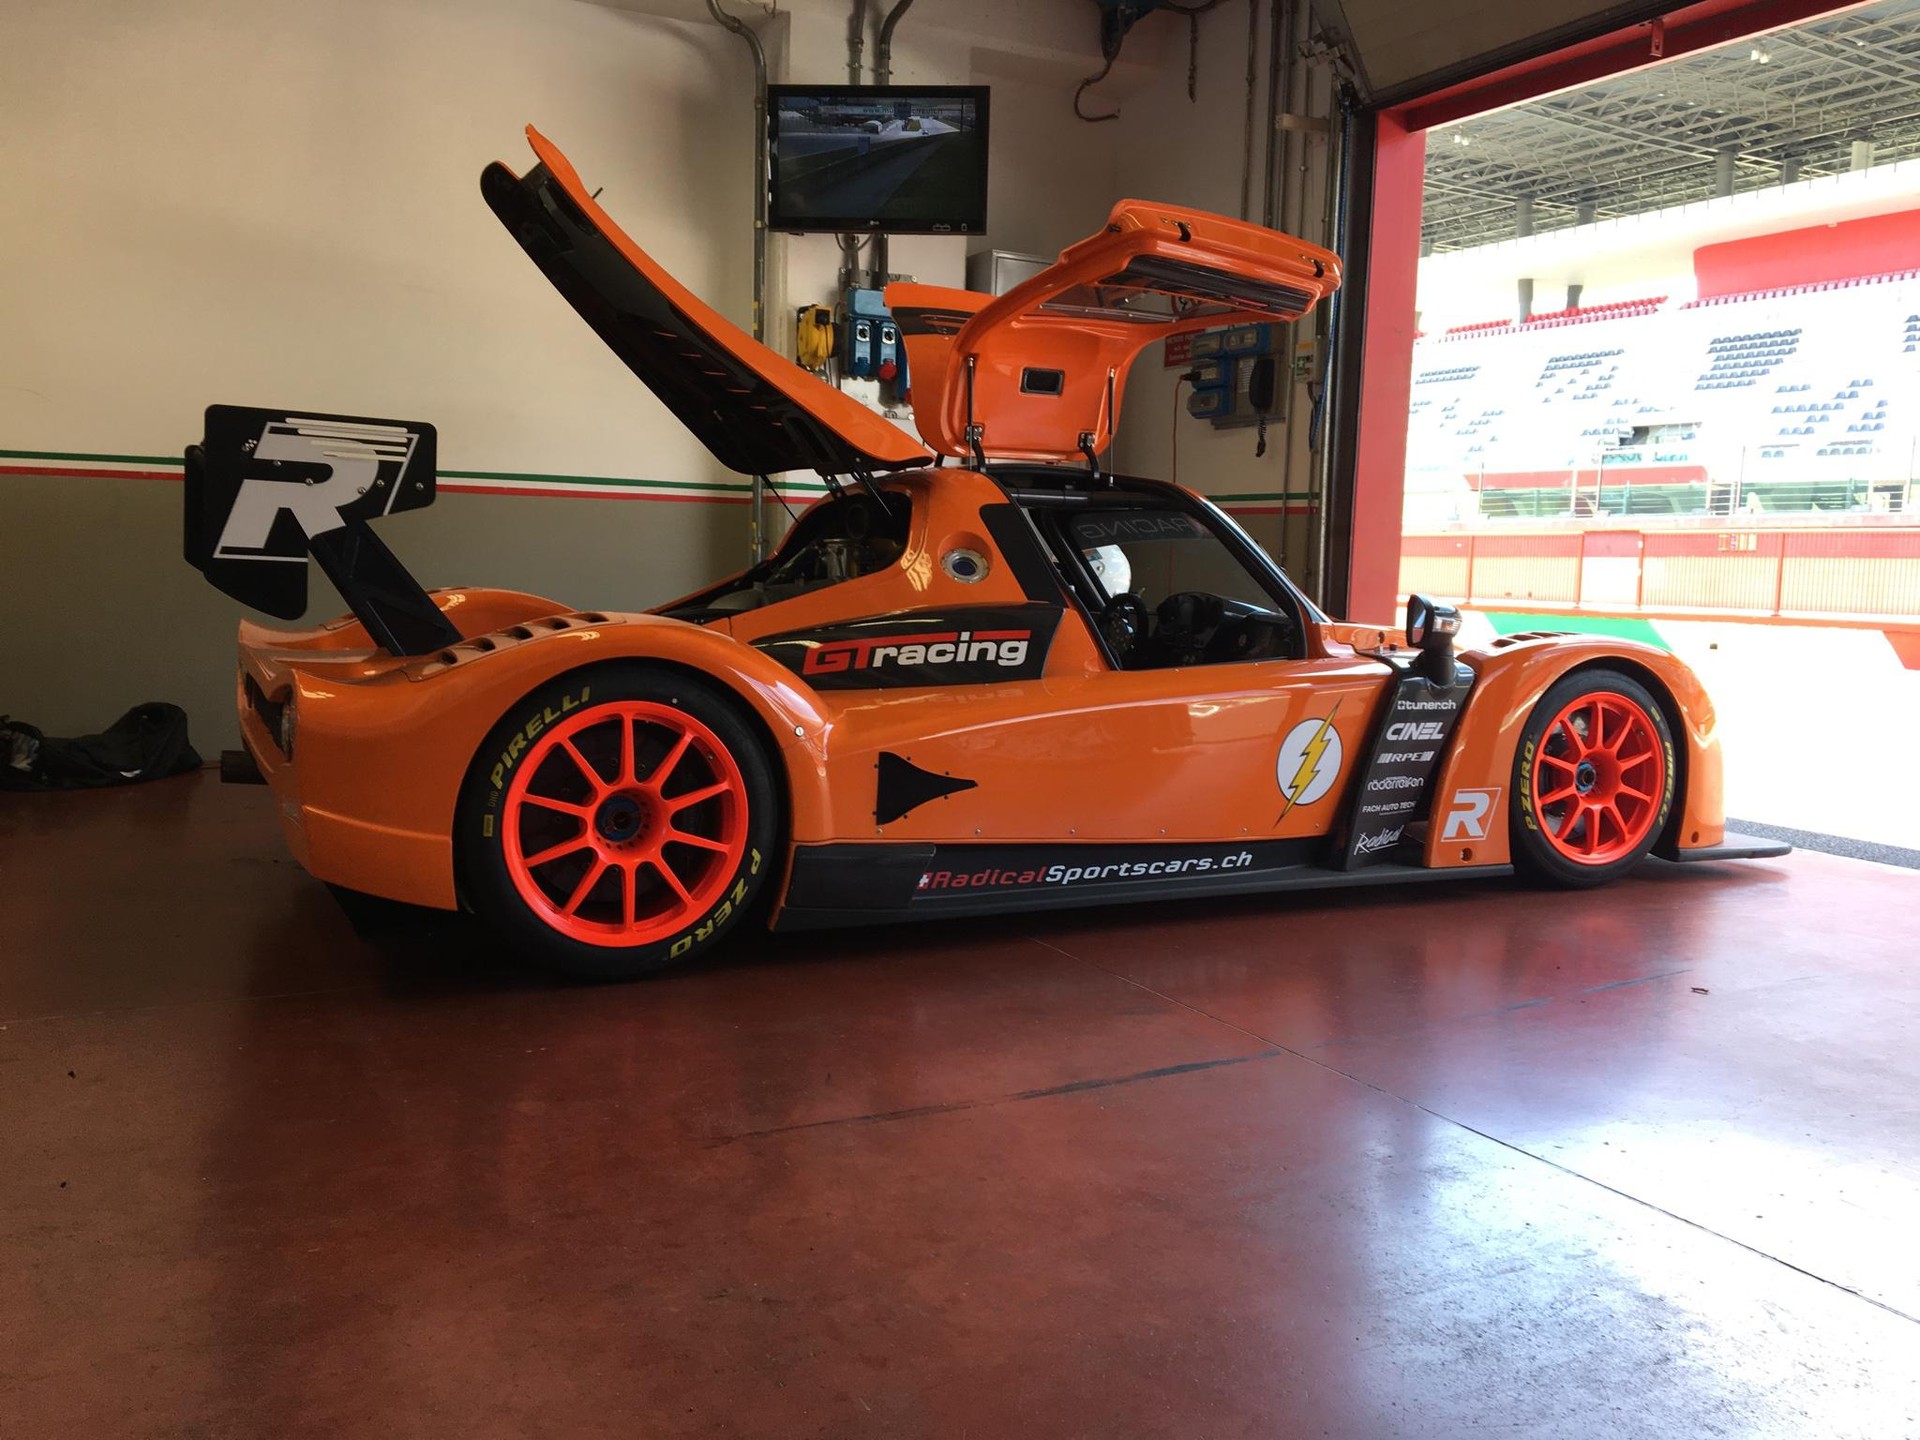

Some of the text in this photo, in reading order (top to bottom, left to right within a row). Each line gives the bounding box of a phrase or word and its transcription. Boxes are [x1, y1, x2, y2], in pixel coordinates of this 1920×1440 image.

[489, 686, 591, 789] PIRELLI
[1386, 722, 1445, 741] CINEL
[1391, 752, 1422, 763] RPE
[1520, 740, 1538, 831] P ZERO
[1362, 805, 1381, 813] FACH
[1381, 803, 1400, 812] AUTO
[1442, 792, 1490, 838] R
[1353, 825, 1405, 856] Radical
[928, 850, 1254, 890] RadicalSportscars.ch
[670, 848, 762, 959] P ZERO
